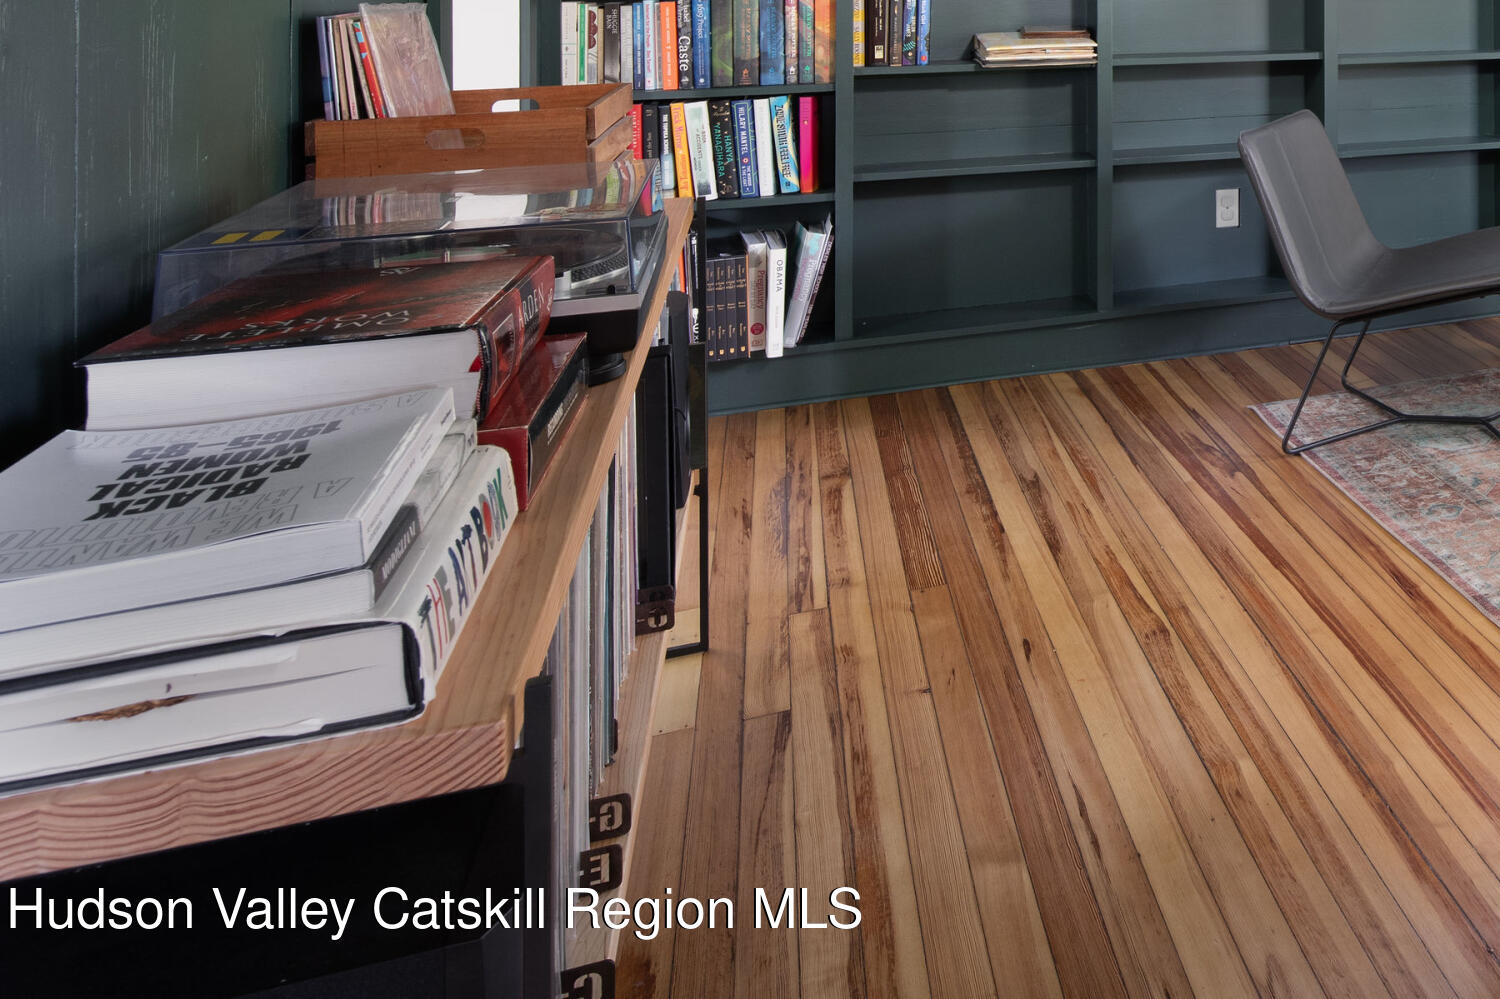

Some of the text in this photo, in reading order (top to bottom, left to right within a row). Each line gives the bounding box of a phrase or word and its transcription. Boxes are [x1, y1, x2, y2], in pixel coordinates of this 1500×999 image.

[696, 4, 704, 17] 1619
[679, 36, 691, 72] Caste
[714, 123, 725, 177] YANAGIHARA
[724, 135, 733, 163] HANYA
[738, 107, 748, 155] HILARY MANTEL
[777, 124, 788, 145] SMITH
[779, 147, 789, 161] FEEL
[781, 162, 791, 178] FREE
[756, 270, 765, 309] Pregnancy
[799, 258, 818, 306] Pregnancy
[518, 282, 545, 328] ARDEN
[87, 453, 312, 501] RADICAL
[117, 439, 309, 481] WOMEN
[82, 477, 269, 522] BLACK
[417, 467, 509, 671] THE ART BOOK
